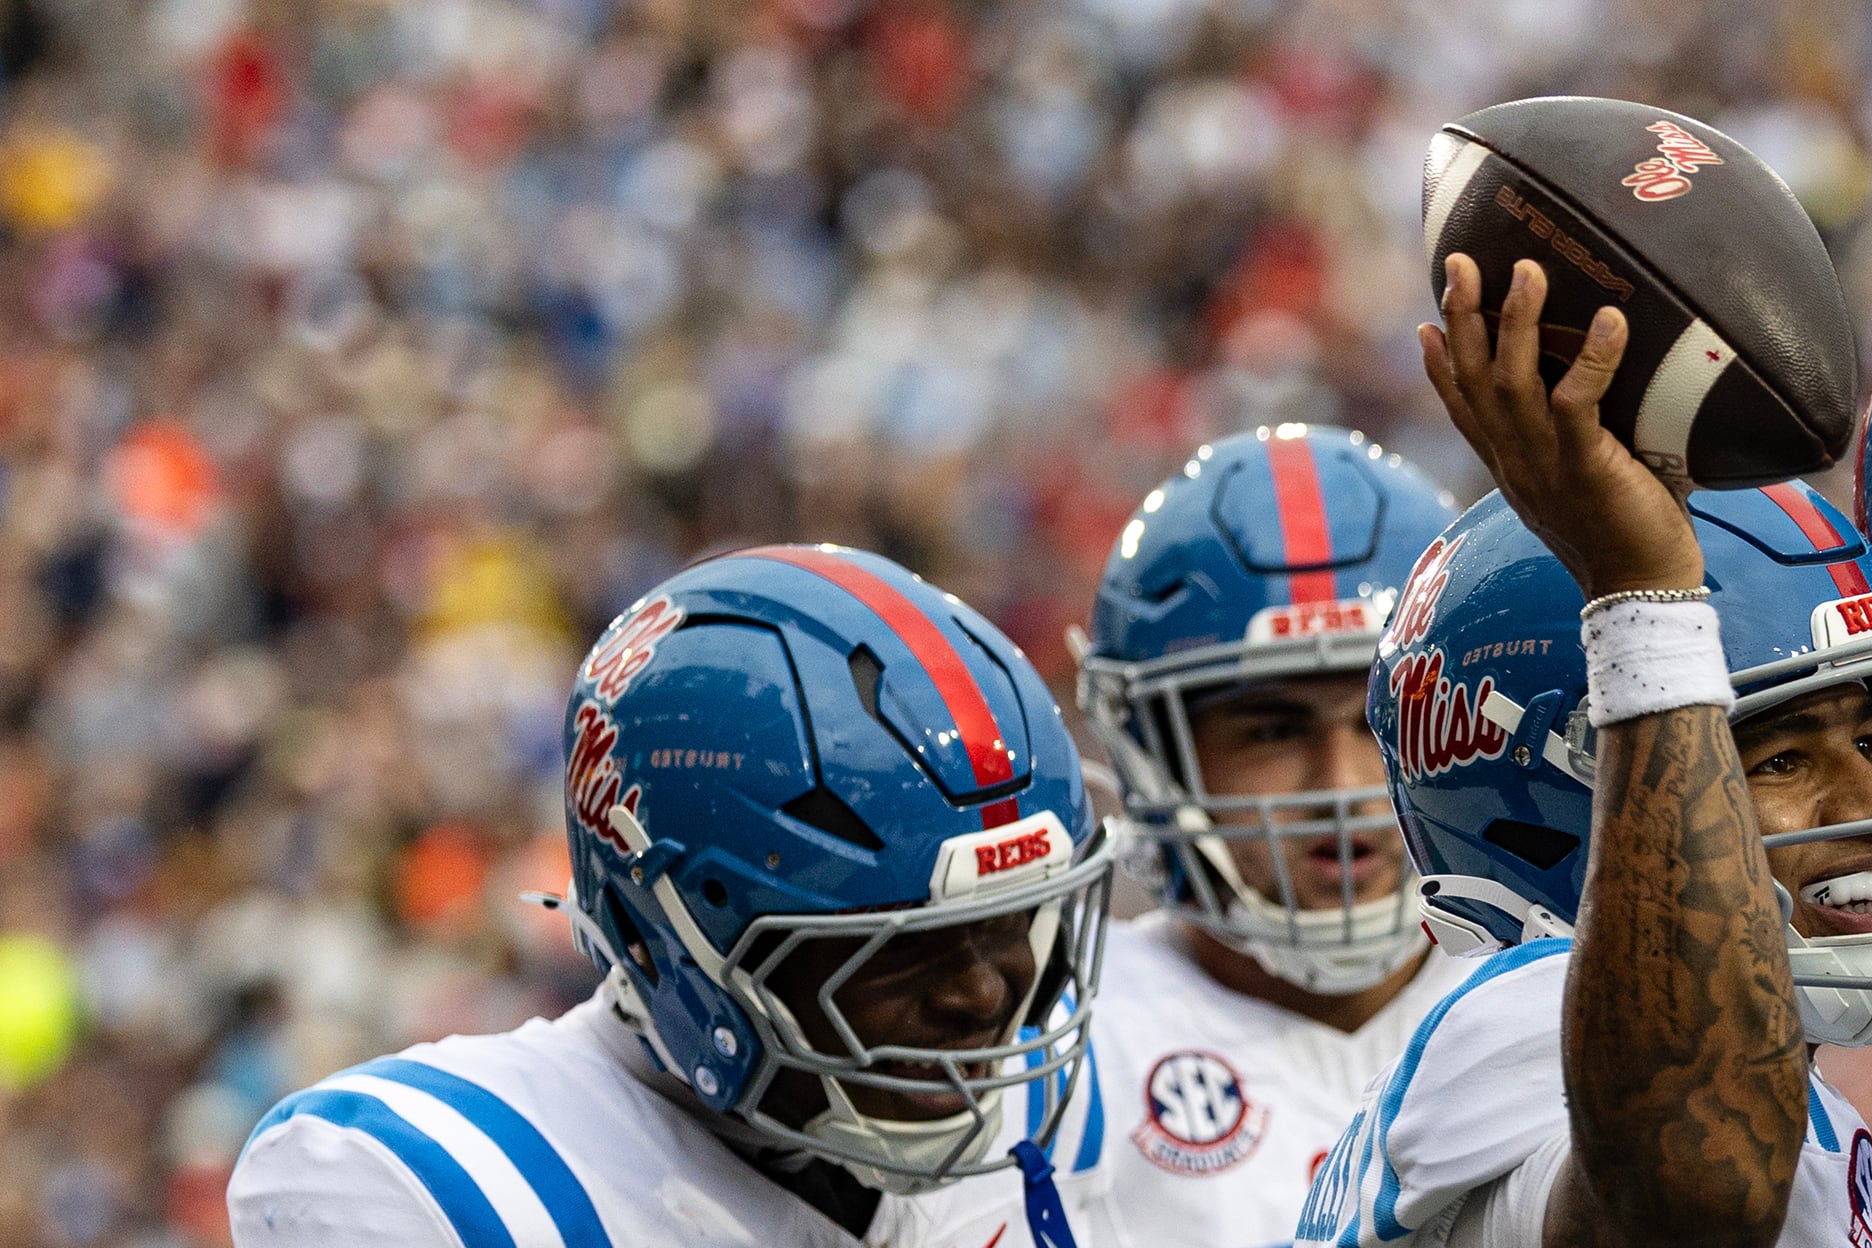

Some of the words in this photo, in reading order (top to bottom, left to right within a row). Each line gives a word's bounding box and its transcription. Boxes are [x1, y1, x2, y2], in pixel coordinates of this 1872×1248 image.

[1645, 120, 1724, 173] Miss
[1621, 157, 1692, 201] Ole
[1551, 228, 1635, 302] VAPOR
[1390, 648, 1507, 785] Miss
[975, 828, 1051, 876] REBS
[1150, 1057, 1240, 1142] SEC
